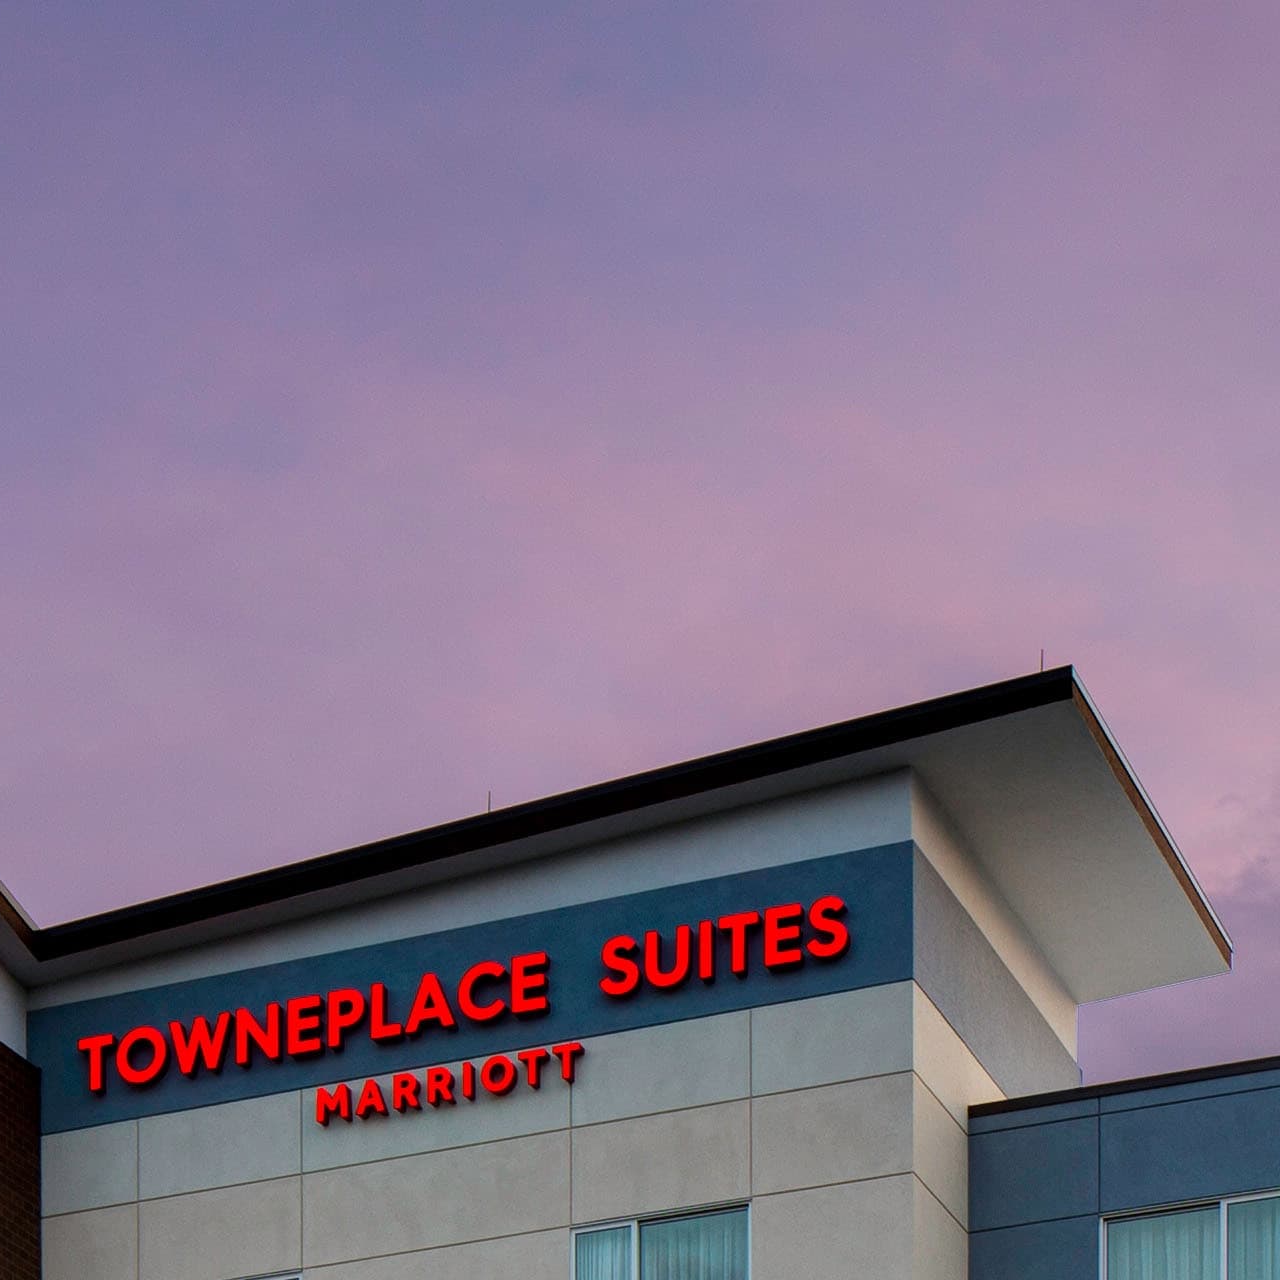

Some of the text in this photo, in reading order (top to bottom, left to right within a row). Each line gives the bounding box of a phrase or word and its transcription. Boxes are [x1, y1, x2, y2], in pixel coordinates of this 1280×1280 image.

[77, 895, 850, 1092] TOWNEPLACE SUITES
[316, 1041, 583, 1126] MARRIOTT
